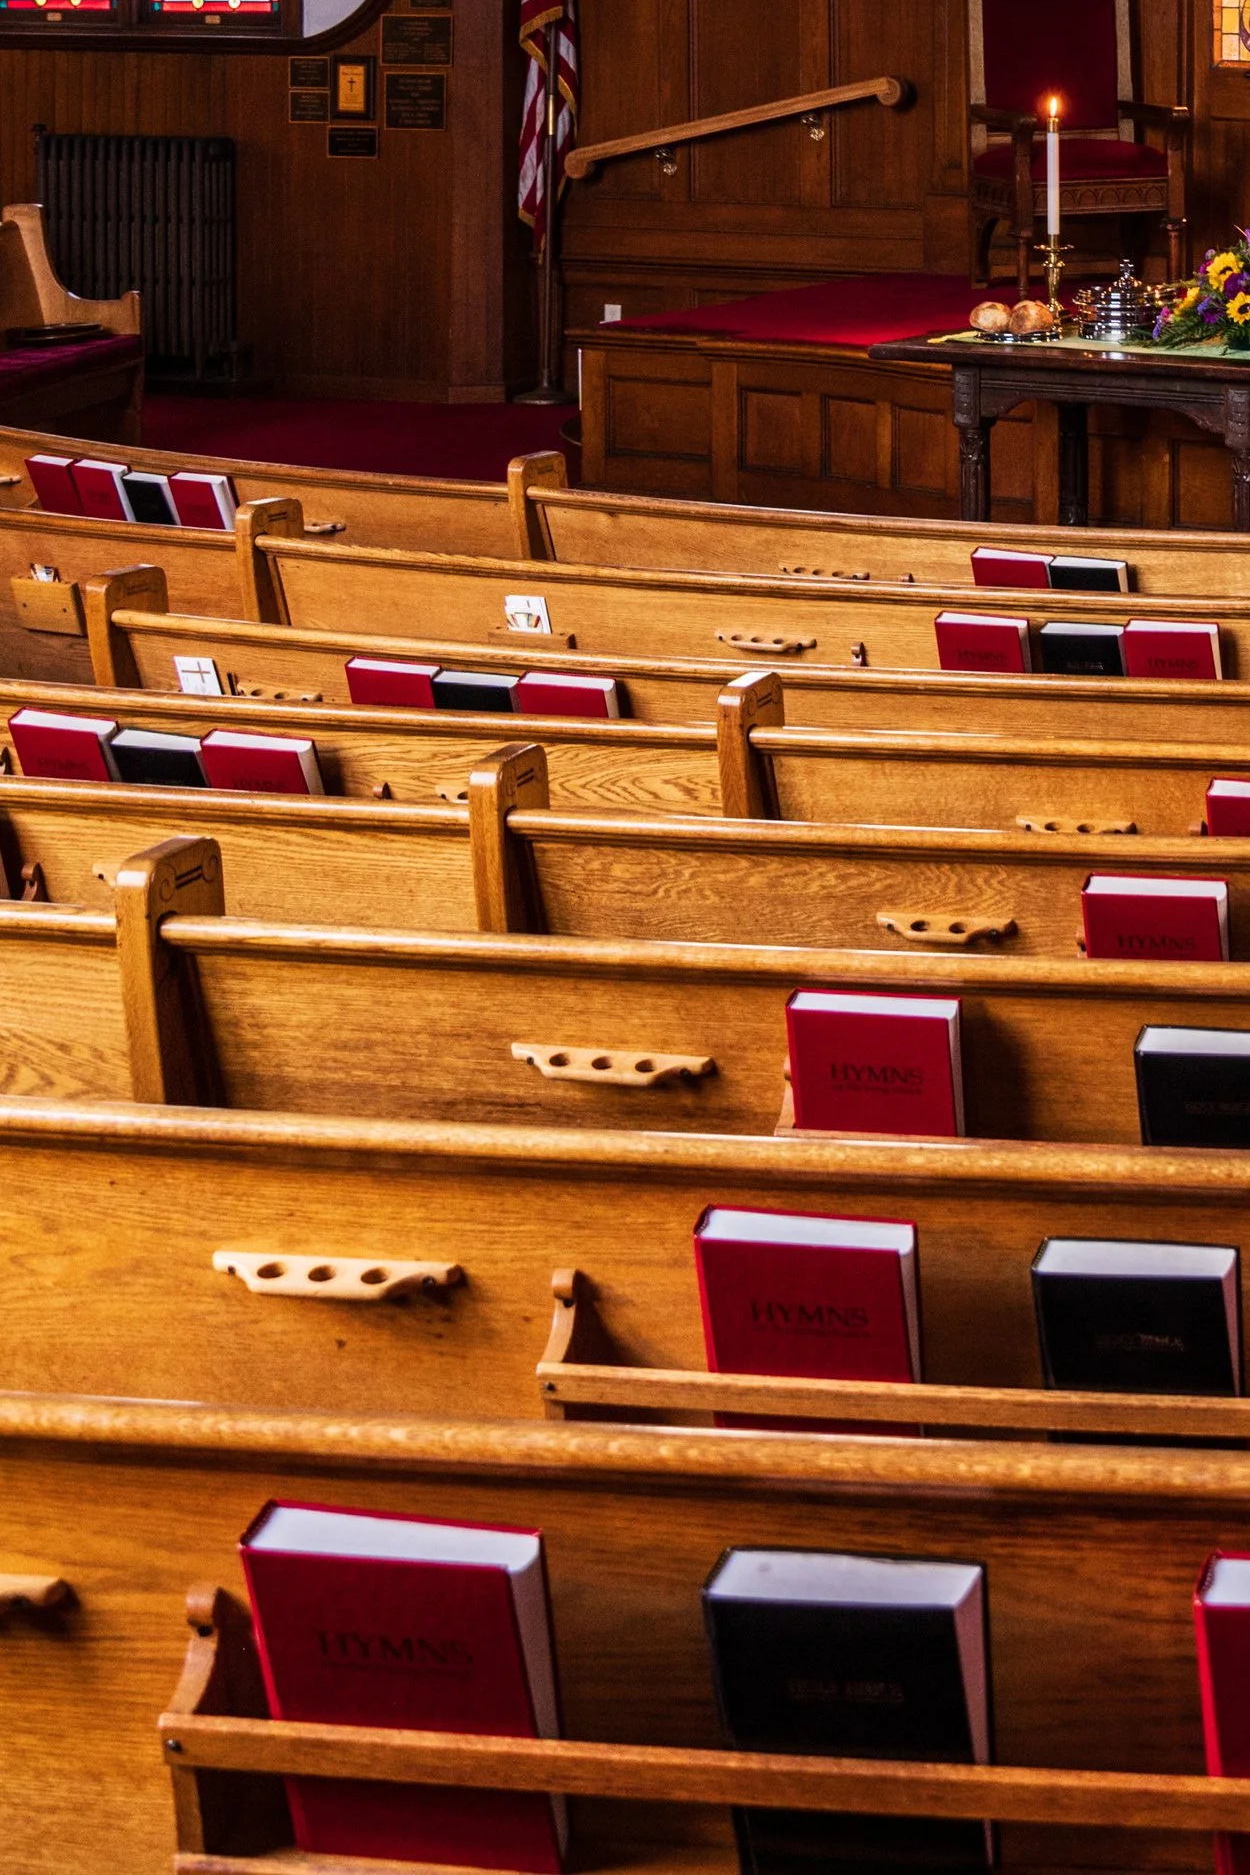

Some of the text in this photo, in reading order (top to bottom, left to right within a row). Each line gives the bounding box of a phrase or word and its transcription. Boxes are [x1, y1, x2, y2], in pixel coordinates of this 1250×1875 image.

[1117, 934, 1197, 951] HYMNS
[830, 1063, 924, 1085] HYMNS
[751, 1300, 869, 1327] HYMNS
[317, 1629, 474, 1665] HYMNS
